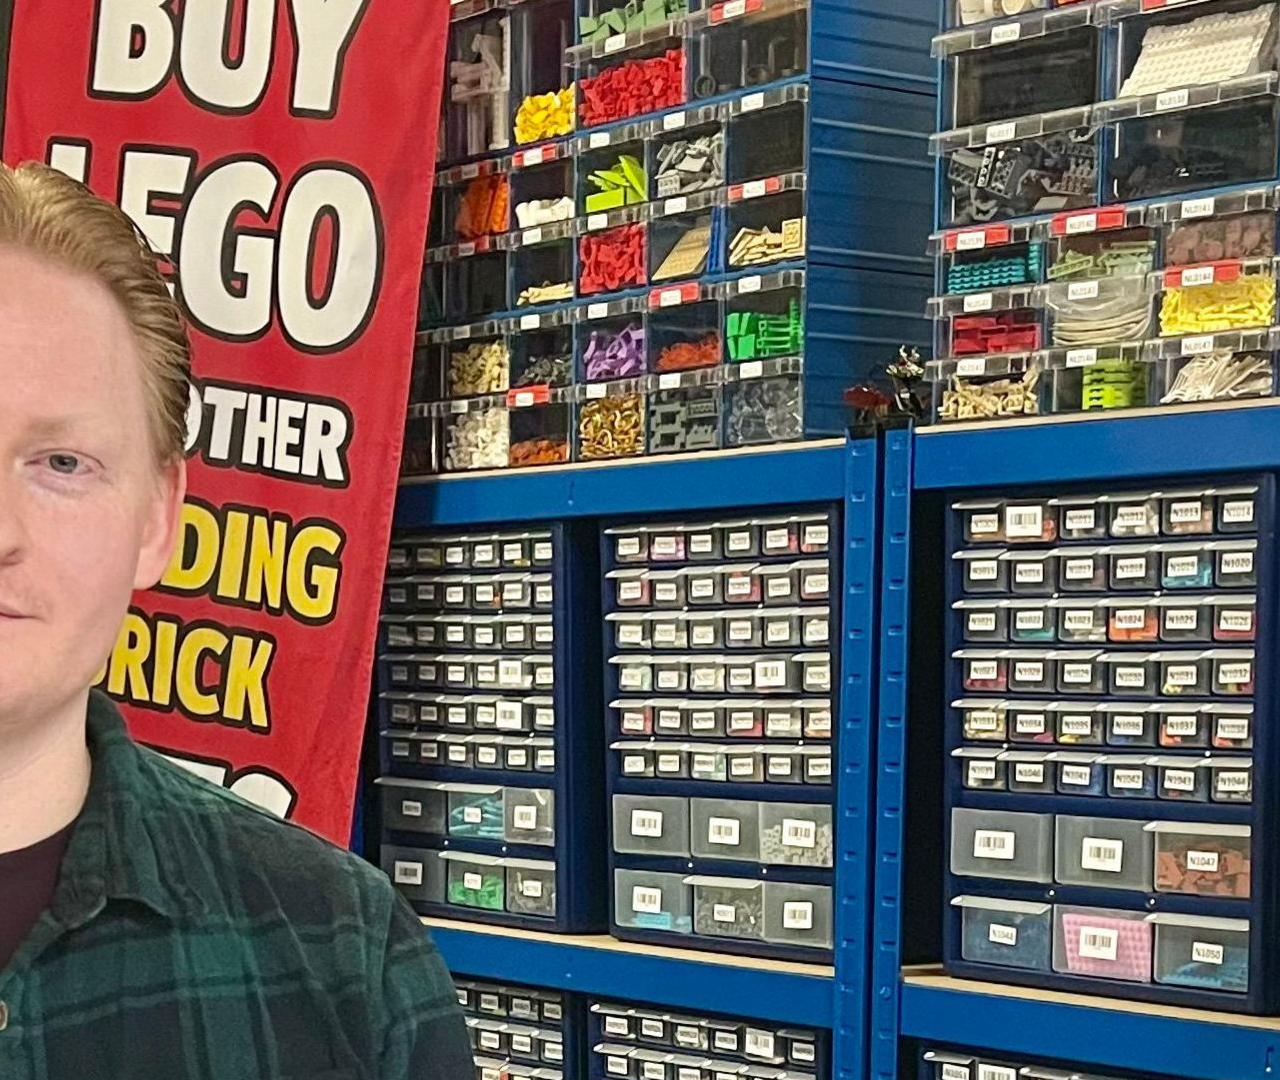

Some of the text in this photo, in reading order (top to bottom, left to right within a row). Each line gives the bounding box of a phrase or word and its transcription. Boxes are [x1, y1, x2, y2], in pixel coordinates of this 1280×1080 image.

[89, 0, 371, 114] BUY
[91, 613, 274, 728] RICK
[1189, 855, 1216, 867] N1047
[1195, 946, 1221, 960] N1050
